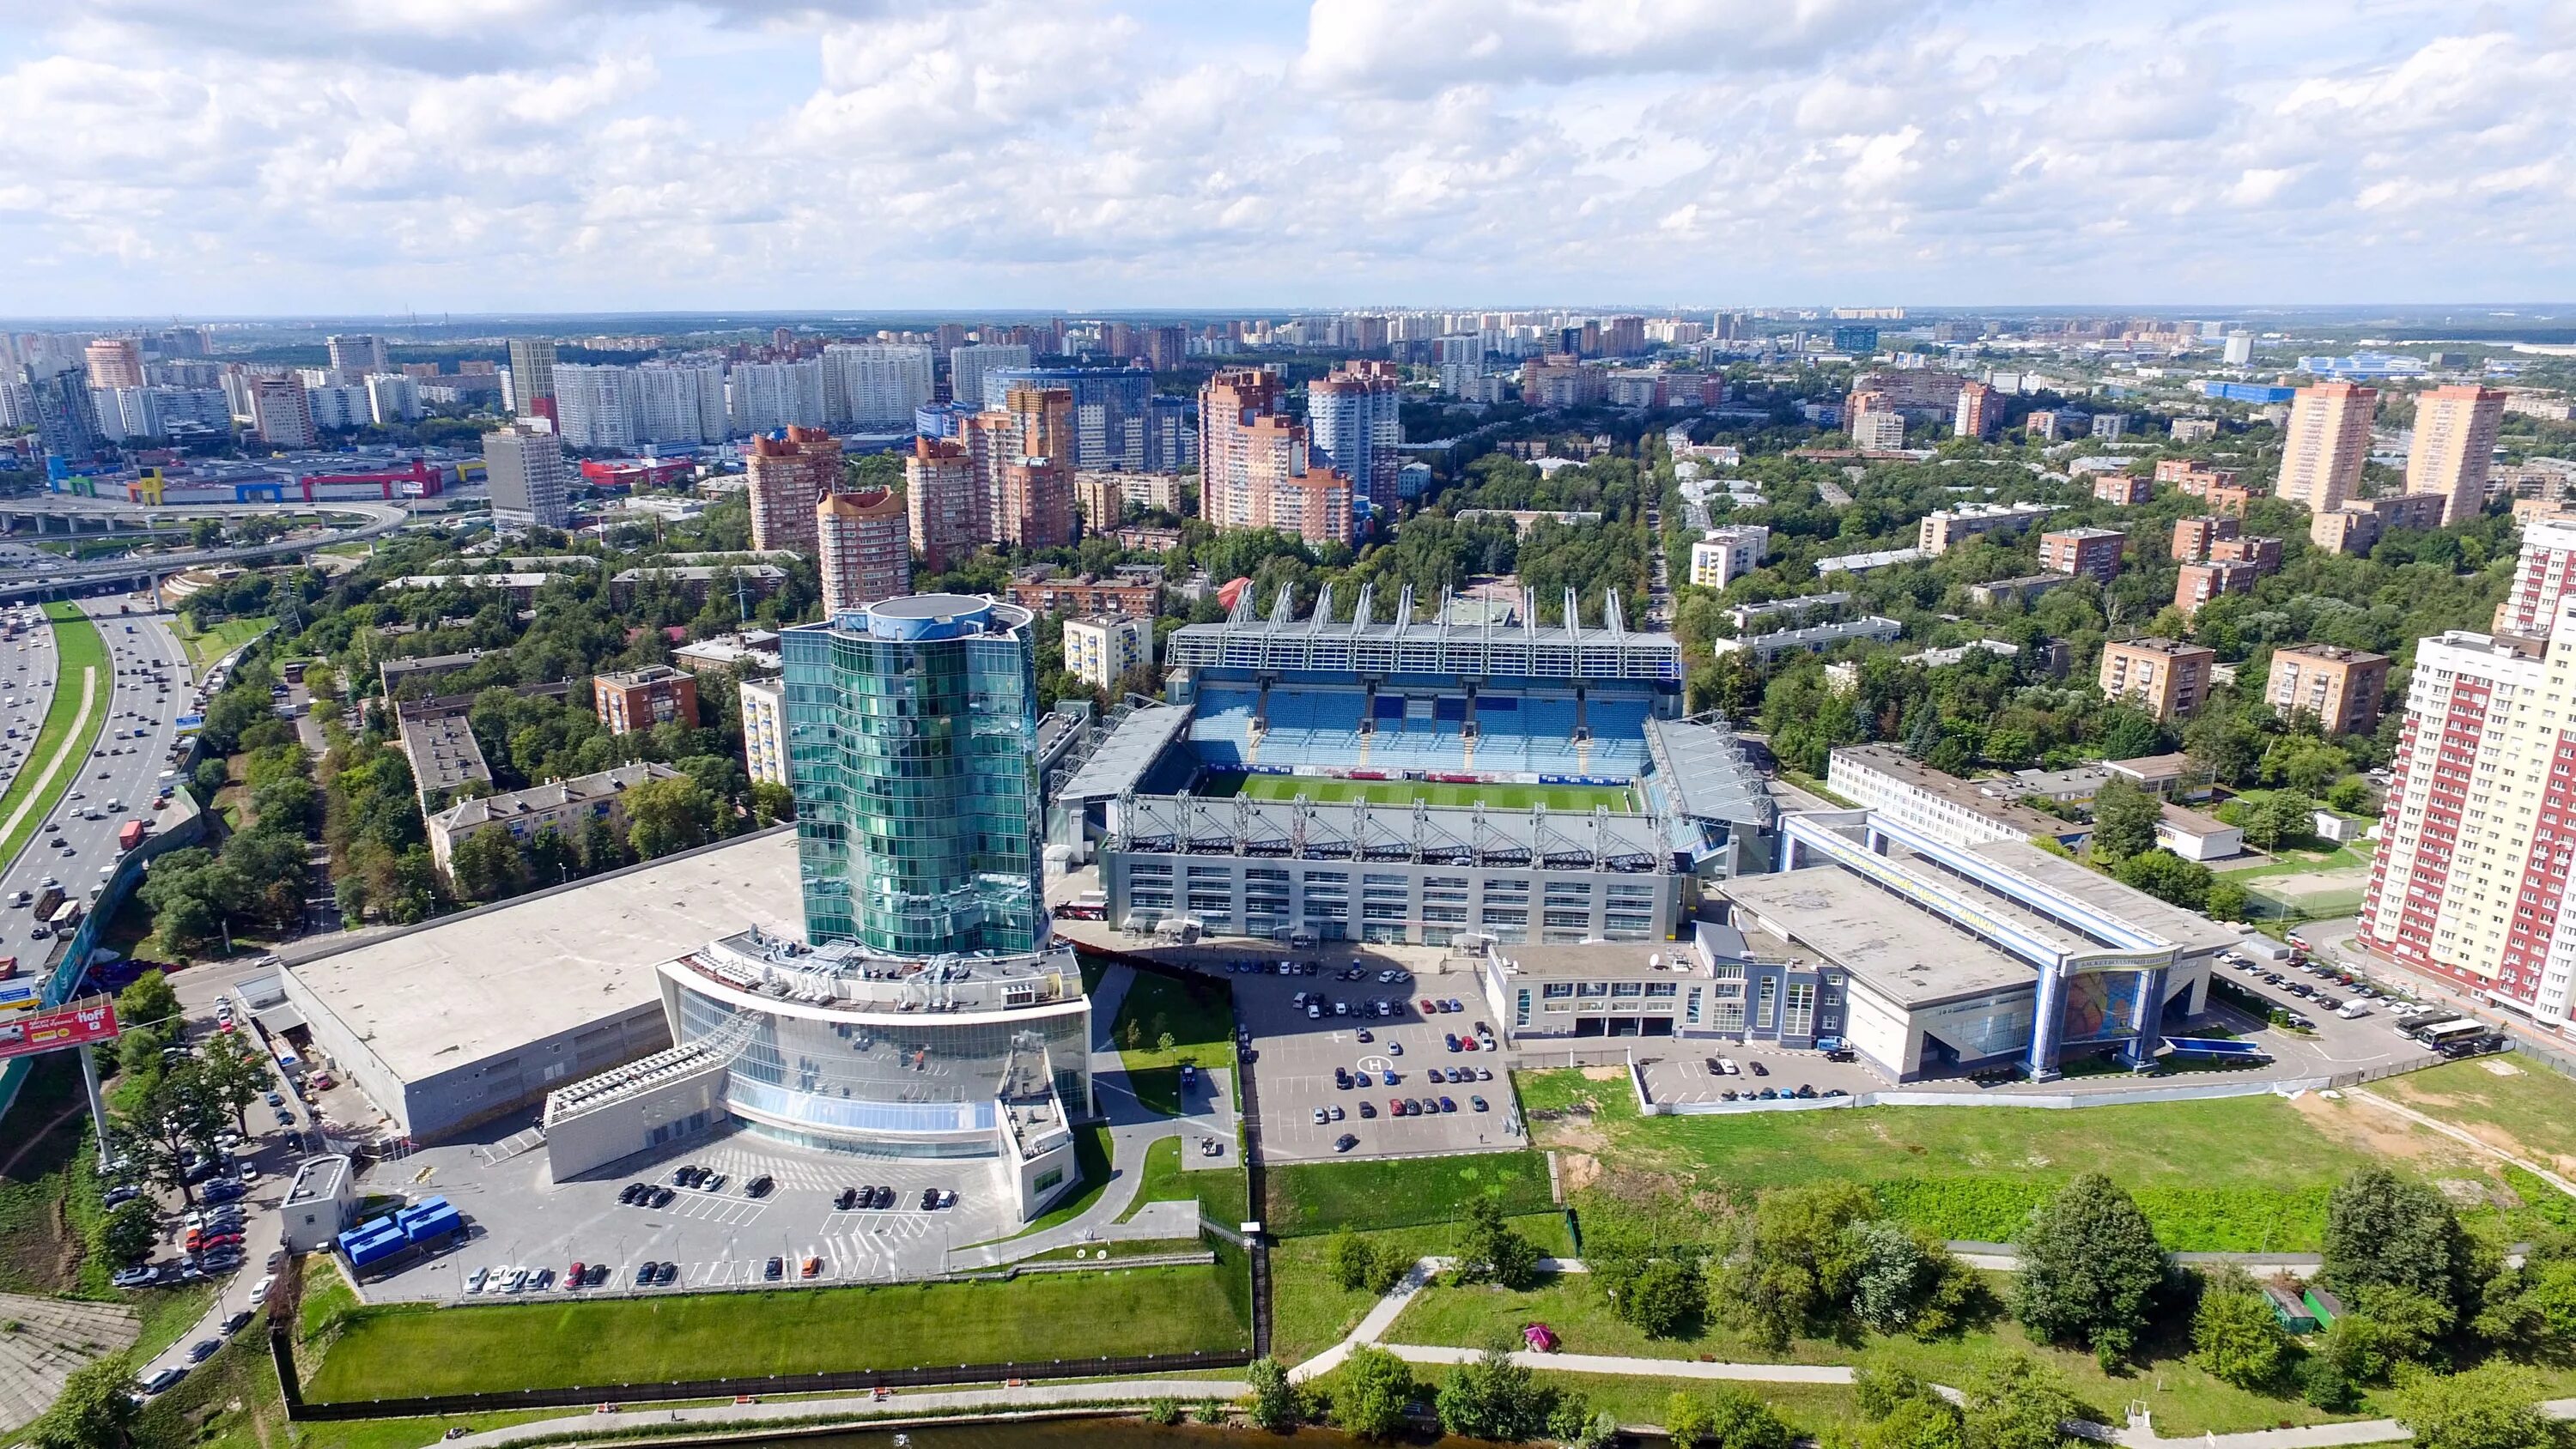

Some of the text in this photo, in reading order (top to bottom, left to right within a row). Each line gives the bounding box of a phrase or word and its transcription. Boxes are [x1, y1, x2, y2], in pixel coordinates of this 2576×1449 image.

[1957, 907, 1996, 935] ХИМКИ
[77, 1009, 106, 1022] Hoff
[1369, 1060, 1382, 1070] H
